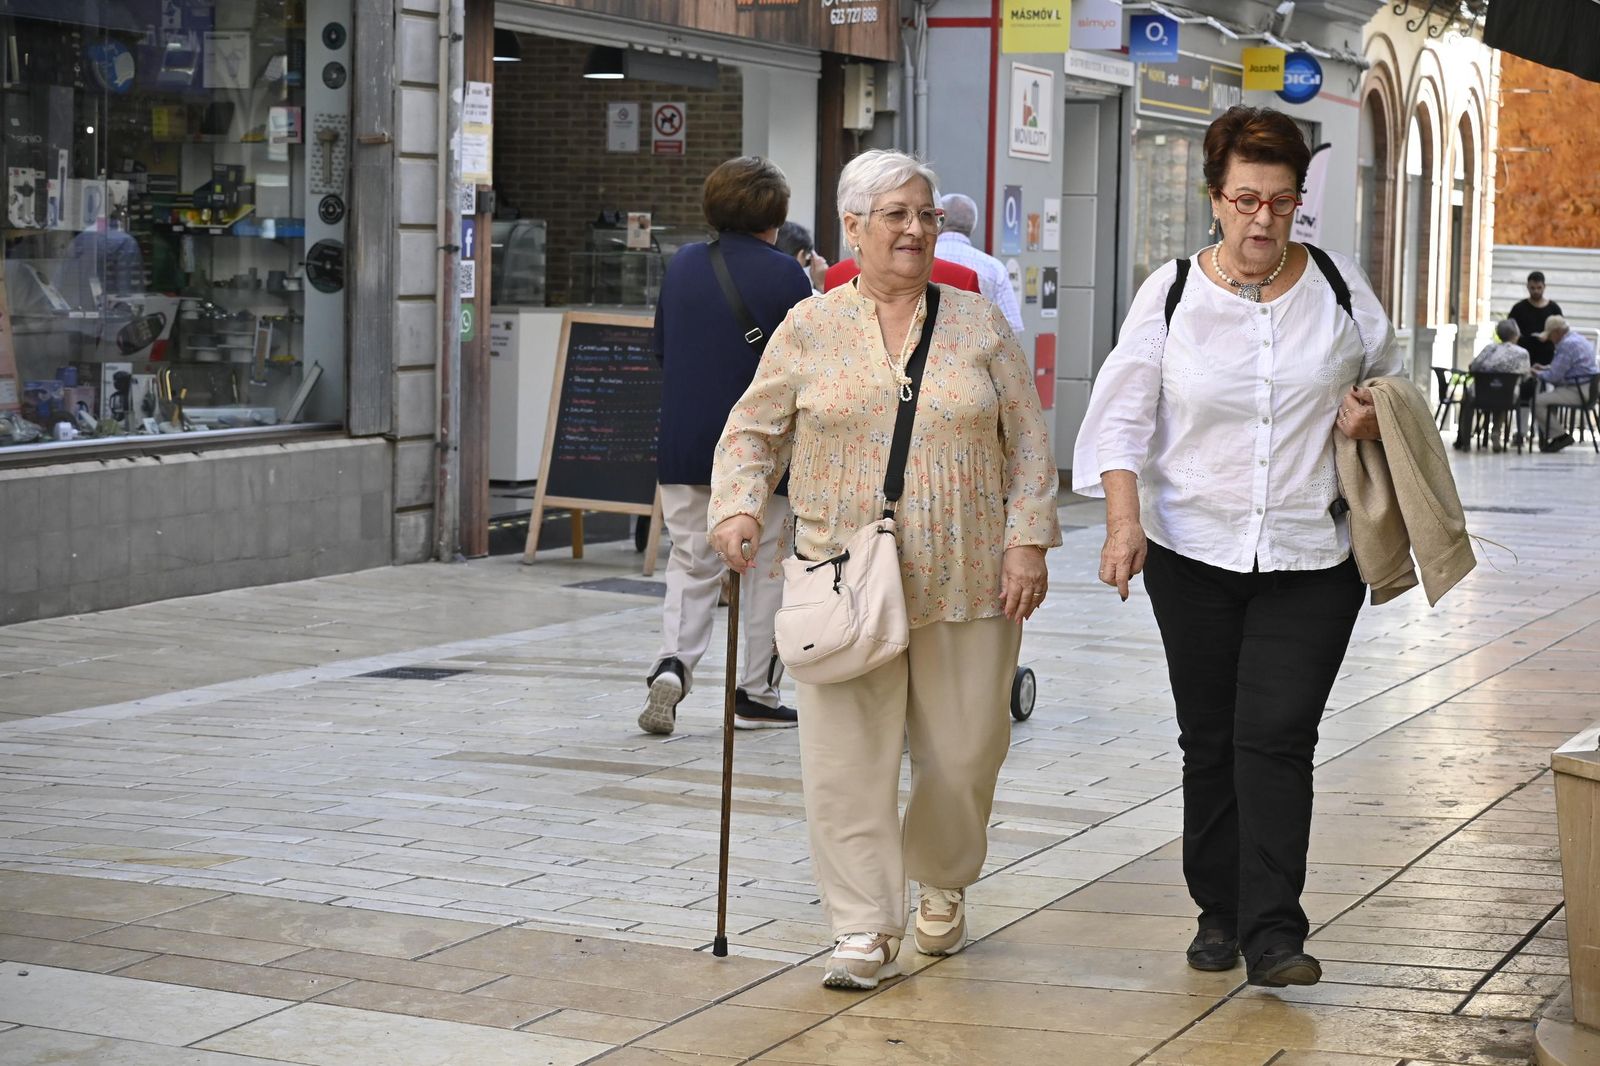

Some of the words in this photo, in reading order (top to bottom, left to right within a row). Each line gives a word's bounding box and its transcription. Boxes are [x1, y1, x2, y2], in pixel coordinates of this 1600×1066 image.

[830, 9, 845, 25] 623
[846, 8, 862, 23] 727
[1077, 17, 1116, 31] simyo
[1249, 64, 1280, 73] Jazztel
[1014, 127, 1048, 146] MOVILCITY
